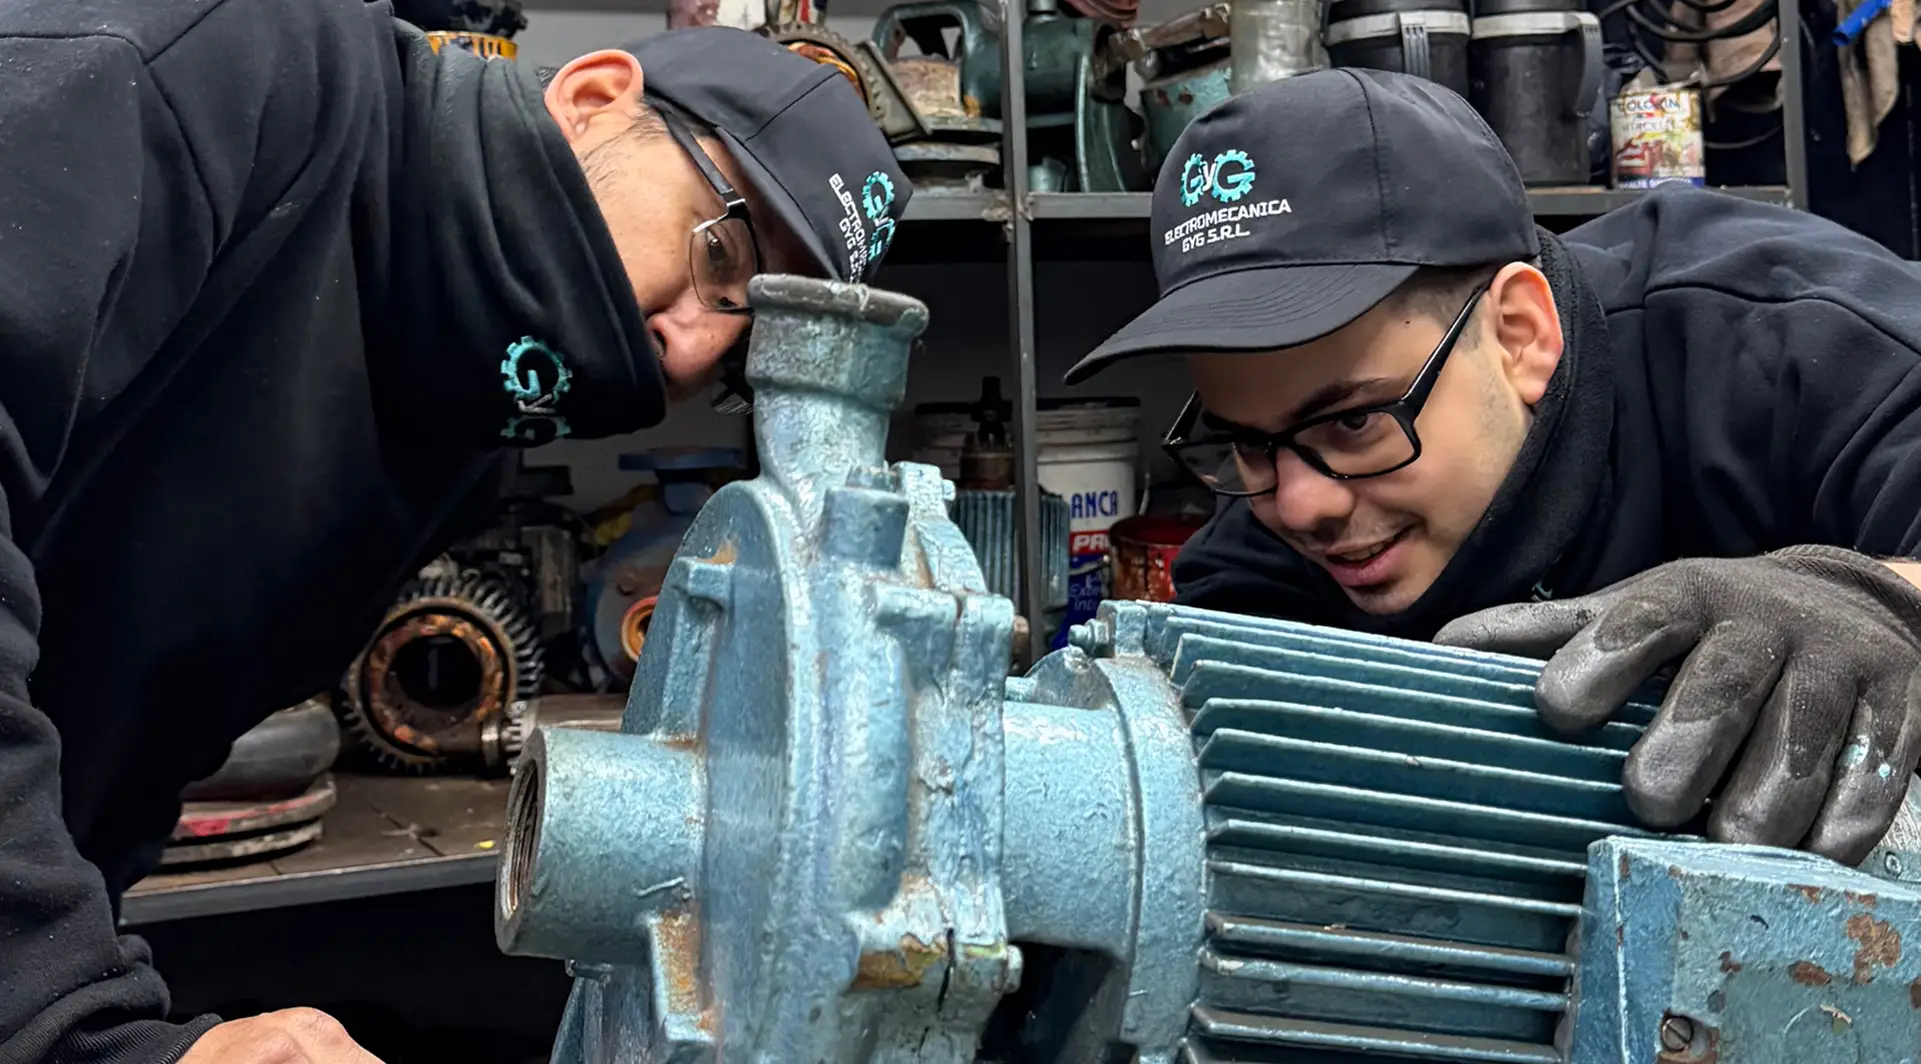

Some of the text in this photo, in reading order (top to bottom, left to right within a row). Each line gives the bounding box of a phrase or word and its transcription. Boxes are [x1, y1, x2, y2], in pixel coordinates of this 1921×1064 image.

[1164, 198, 1292, 245] ELECTROMECANICA
[1182, 231, 1206, 253] GYG
[1070, 490, 1119, 519] ANCA
